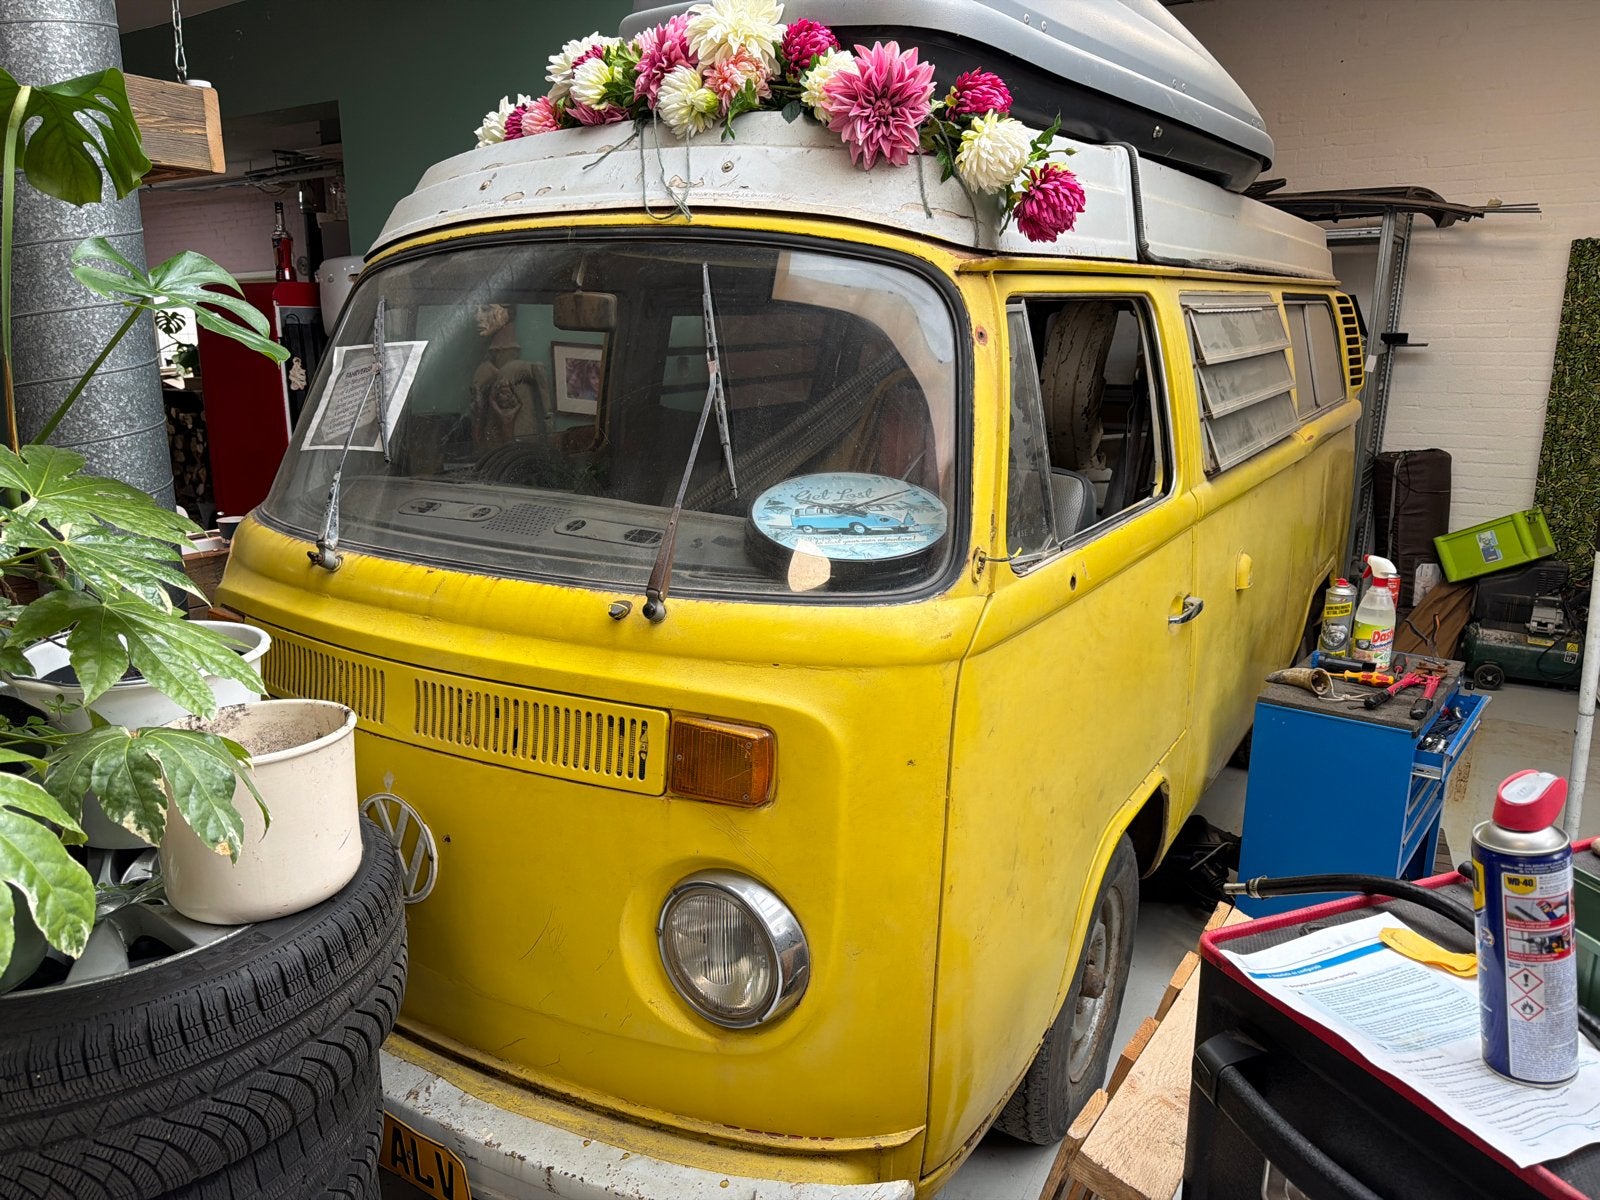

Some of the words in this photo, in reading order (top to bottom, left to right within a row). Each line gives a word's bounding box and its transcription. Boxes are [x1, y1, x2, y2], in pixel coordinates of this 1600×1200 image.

[792, 489, 832, 501] Get
[833, 488, 874, 502] Lost
[1507, 876, 1534, 887] WD-40
[390, 1126, 455, 1200] ALV
